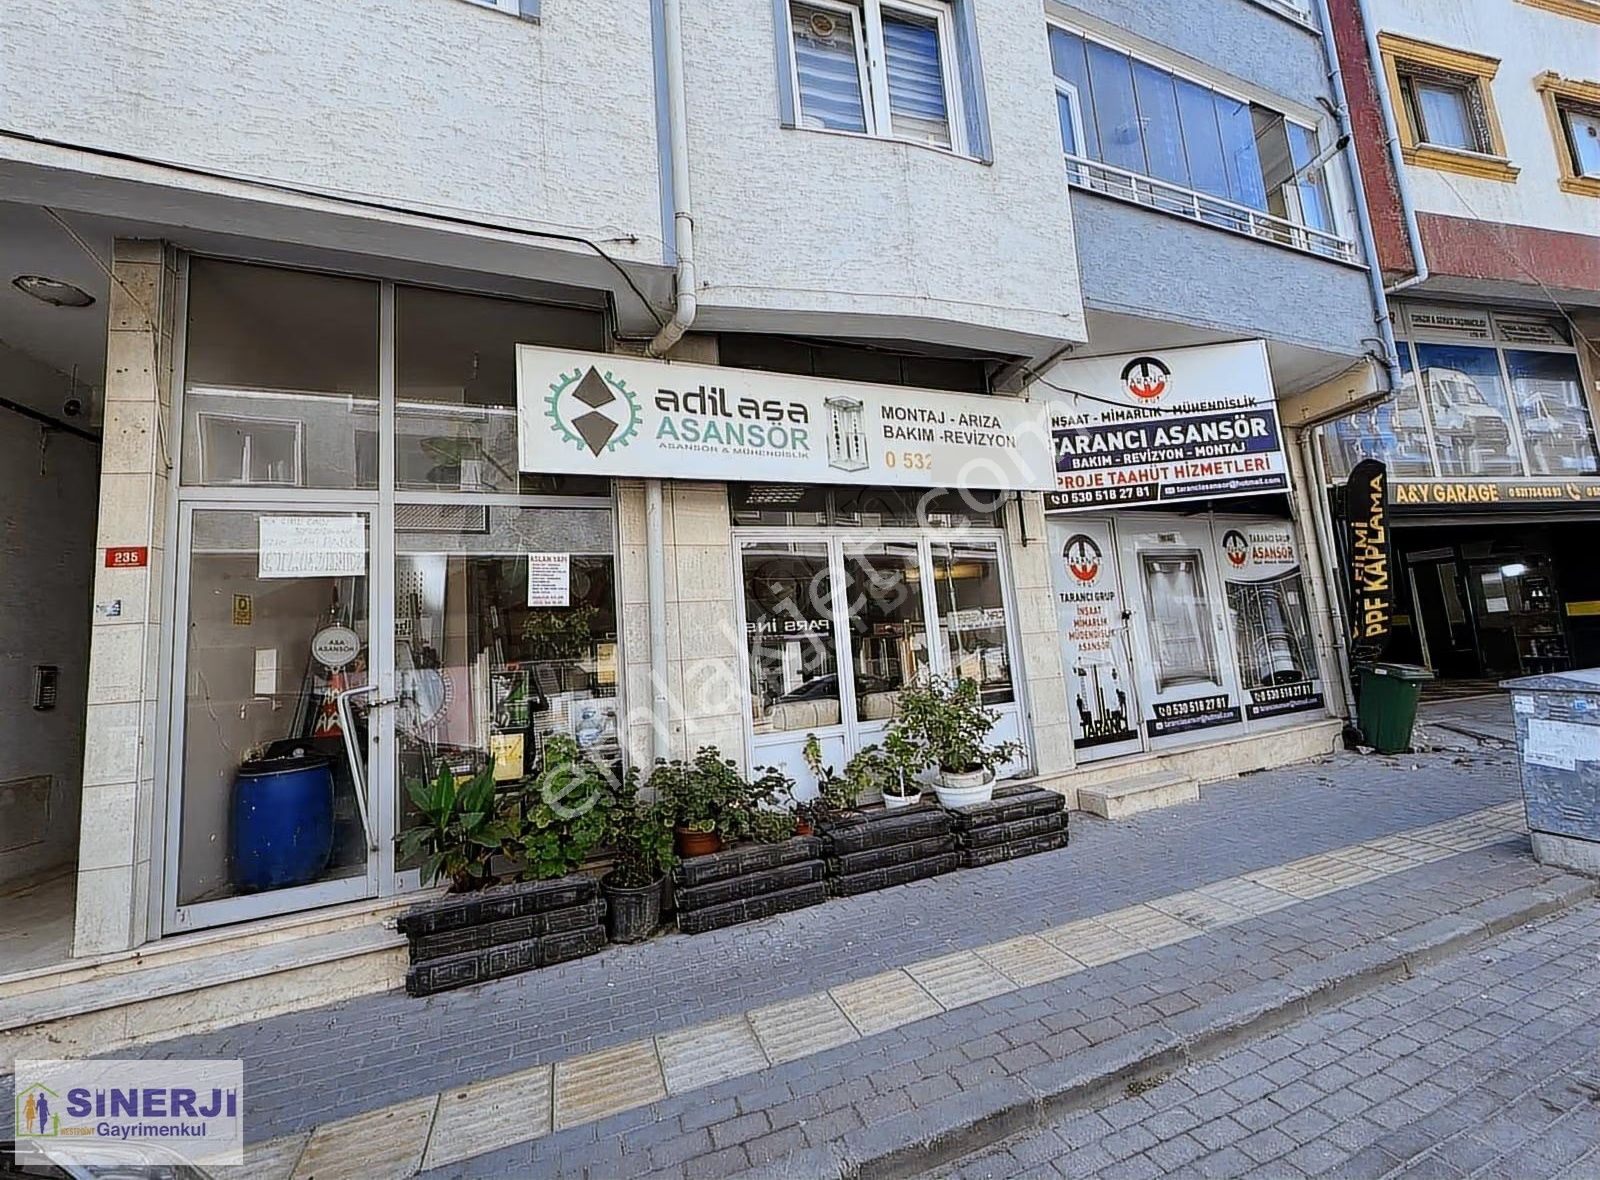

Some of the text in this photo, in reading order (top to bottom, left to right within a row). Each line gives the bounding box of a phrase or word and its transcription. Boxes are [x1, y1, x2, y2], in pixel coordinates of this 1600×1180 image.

[655, 385, 733, 418] adil
[881, 405, 945, 424] MONTAJ
[959, 413, 1001, 429] ARIZA
[1051, 414, 1089, 427] NŞAAT
[656, 415, 810, 450] ASANSÖR
[883, 425, 934, 442] BAKIM
[1154, 414, 1269, 447] ASANSÖR
[885, 451, 896, 468] 0
[1072, 455, 1112, 469] BAKIM
[1123, 447, 1184, 464] REVİZYON
[1195, 442, 1245, 457] MONTAJ
[1107, 462, 1168, 485] TAAHÜT
[1174, 453, 1271, 479] HİZMETLERİ
[1061, 486, 1150, 504] 0 530 518 27 81
[1396, 484, 1428, 503] A&Y
[1433, 483, 1499, 502] GARAGE
[114, 552, 139, 563] 235
[1363, 473, 1389, 637] PPF KAPLAMA
[1174, 703, 1189, 715] 530
[1205, 698, 1215, 711] 27
